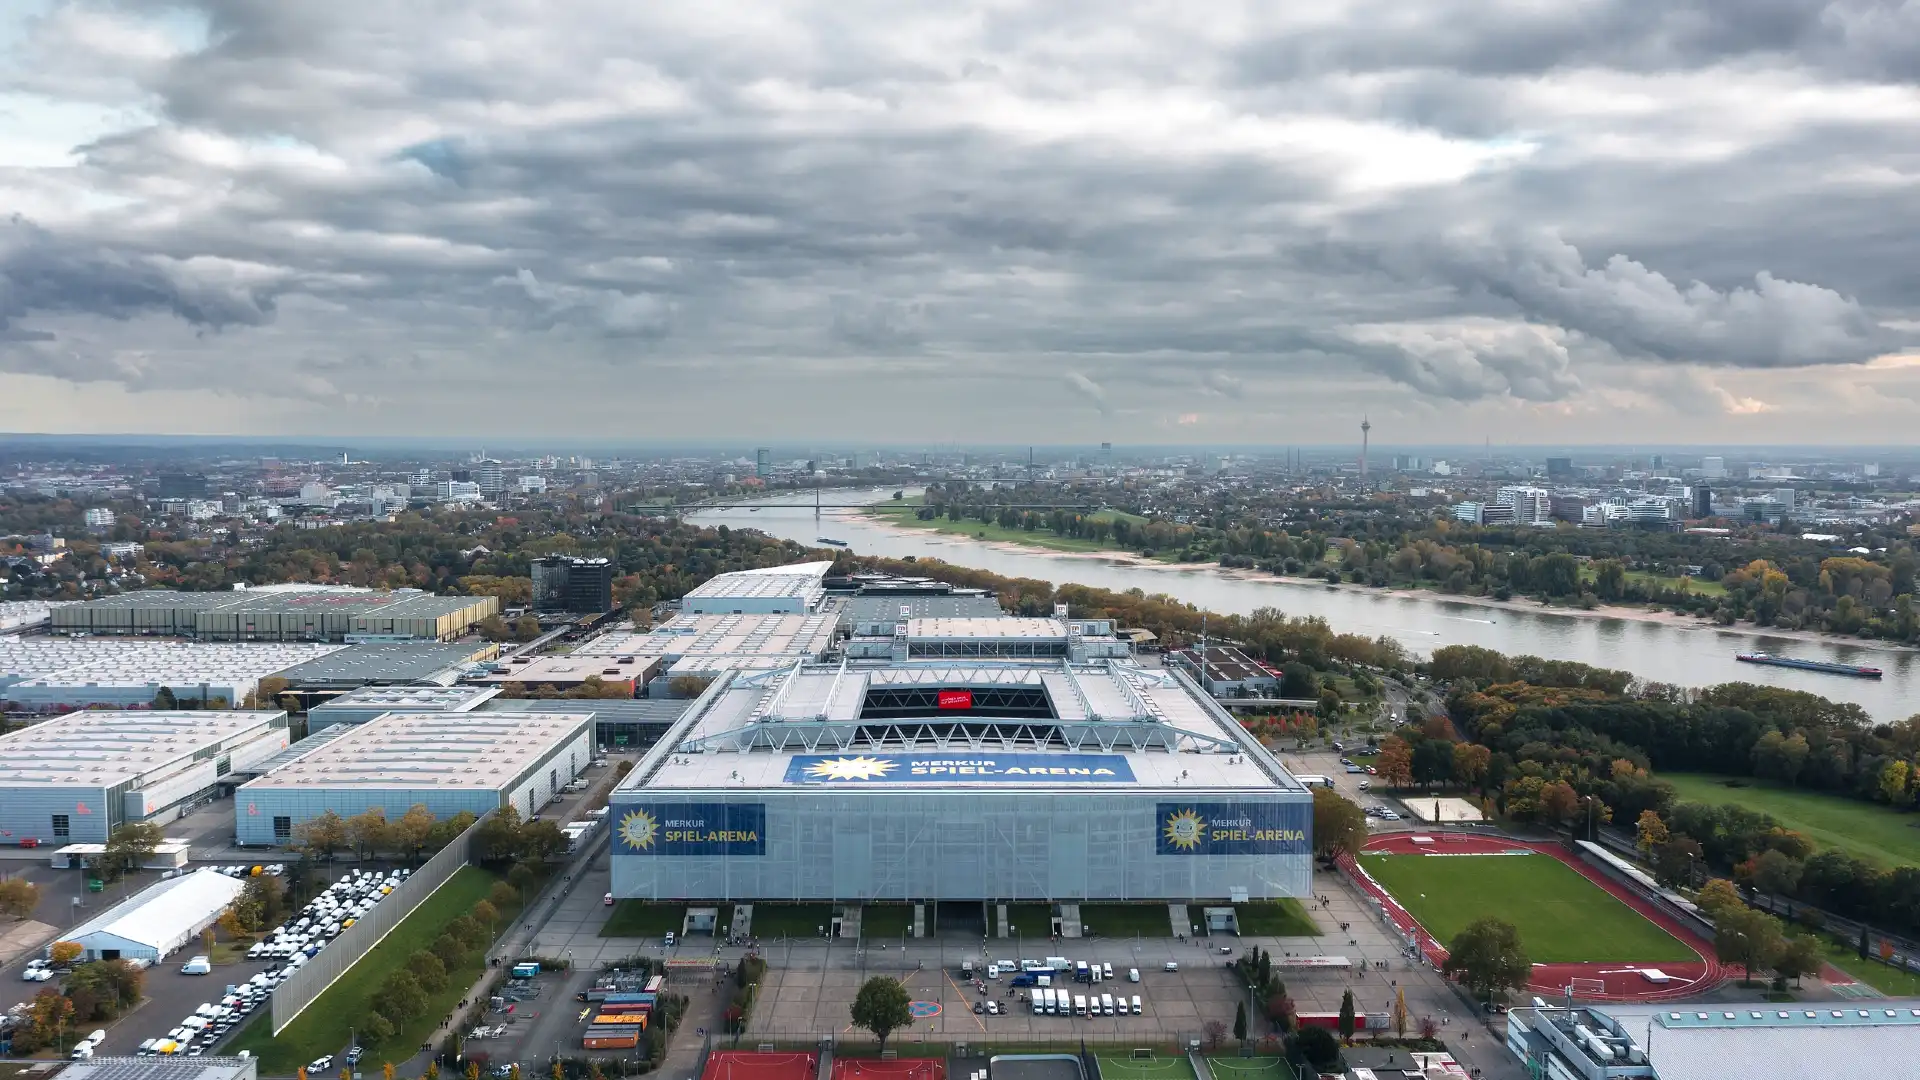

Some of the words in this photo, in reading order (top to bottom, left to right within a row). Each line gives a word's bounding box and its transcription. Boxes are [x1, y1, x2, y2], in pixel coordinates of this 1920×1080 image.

[911, 767, 1116, 776] SPIEL-ARENA
[665, 819, 705, 828] MERKUR
[1212, 819, 1252, 827] MERKUR
[665, 831, 758, 842] SPIEL-ARENA
[1212, 830, 1305, 841] SPIEL-ARENA
